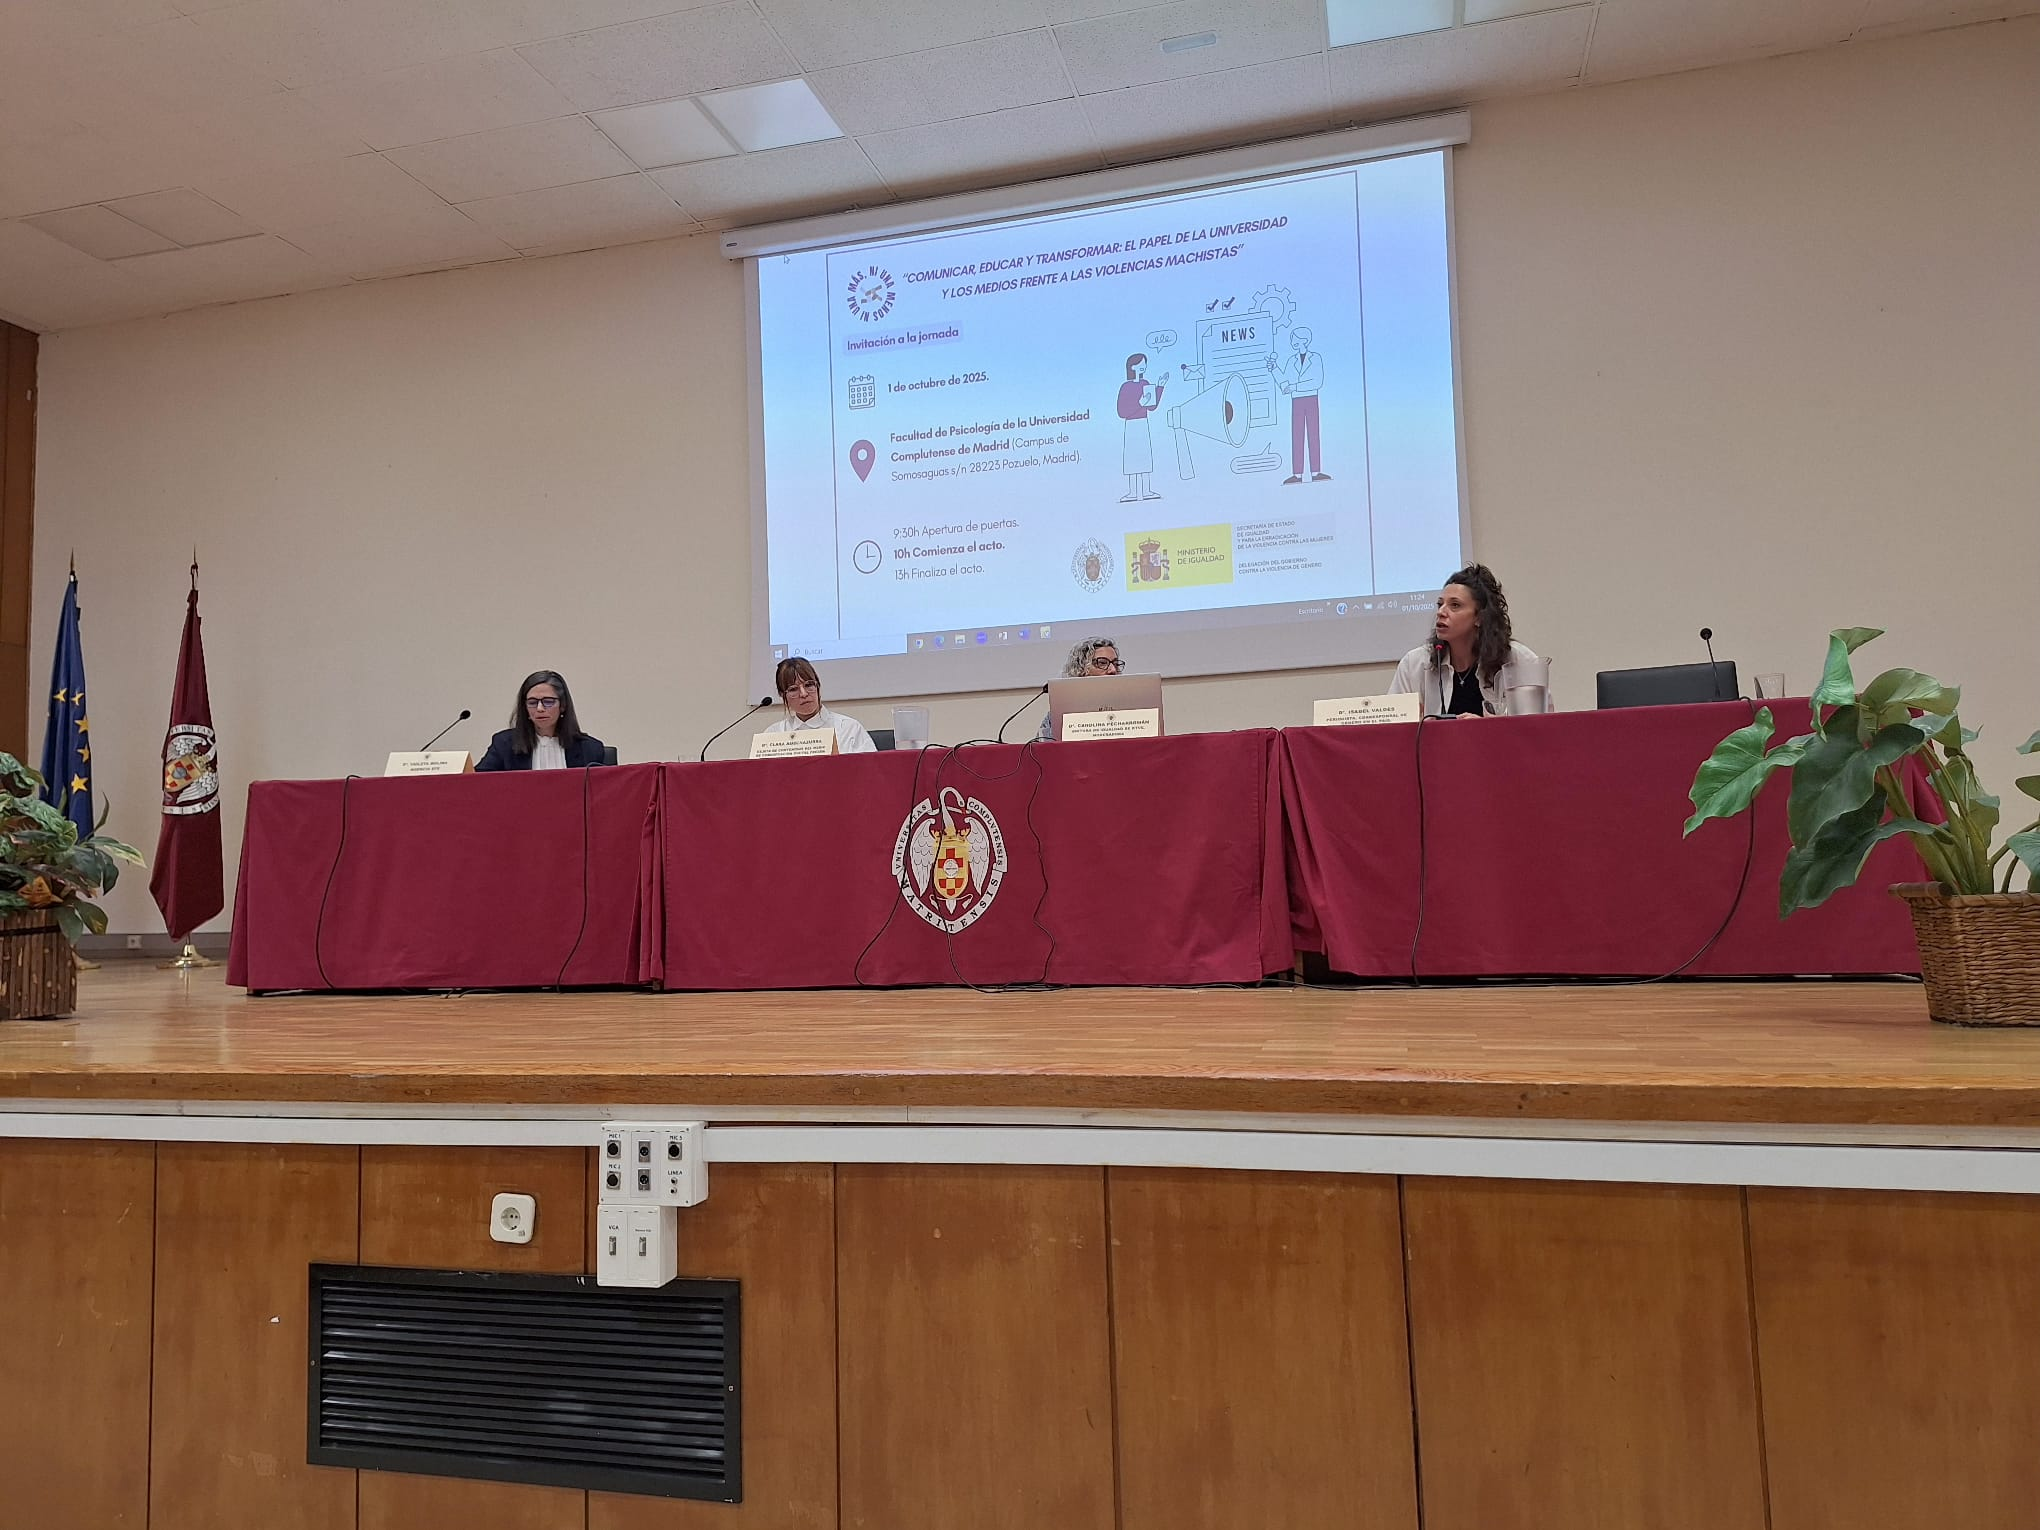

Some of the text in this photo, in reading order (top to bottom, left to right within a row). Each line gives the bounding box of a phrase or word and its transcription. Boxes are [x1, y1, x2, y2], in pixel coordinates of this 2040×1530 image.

[979, 257, 1023, 274] EDUCAR
[1026, 255, 1033, 266] Y
[1036, 243, 1122, 265] TRANSFORMAR:
[1124, 239, 1136, 251] EL
[1139, 234, 1173, 249] PAPEL
[1175, 231, 1190, 244] DE
[1192, 229, 1207, 242] LA
[1209, 216, 1288, 238] UNIVERSIDAD
[869, 265, 878, 277] NI
[880, 269, 895, 289] UNA
[942, 288, 950, 299] Y
[950, 286, 972, 298] LOS
[974, 279, 1017, 295] MEDIOS
[1019, 273, 1058, 289] FRENTE
[1059, 272, 1068, 283] A
[1071, 268, 1093, 281] LAS
[1095, 257, 1163, 278] VIOLENCIAS
[847, 296, 860, 316] UNA
[860, 311, 870, 322] NI
[873, 291, 896, 322] MENOS
[847, 326, 959, 350] Invitación a la jornada
[1221, 326, 1255, 343] NEWS
[888, 371, 990, 393] 1 de octubre de 2025.
[890, 409, 1090, 443] Facultad de Psicología de la Universidad
[890, 432, 1069, 463] Complutense de Madrid (Campus de
[891, 450, 1082, 481] Somosaguas s/n 28223 Pozuelo, Madrid).
[893, 518, 1019, 539] 9:30h Apertura de puertas.
[894, 540, 1005, 559] 10h Comienza el acto.
[1177, 546, 1216, 556] MINISTERIO
[1187, 554, 1225, 564] IGUALDAD
[895, 562, 985, 580] 13h Finaliza el acto.
[968, 801, 1003, 866] COMPLVTENSIS
